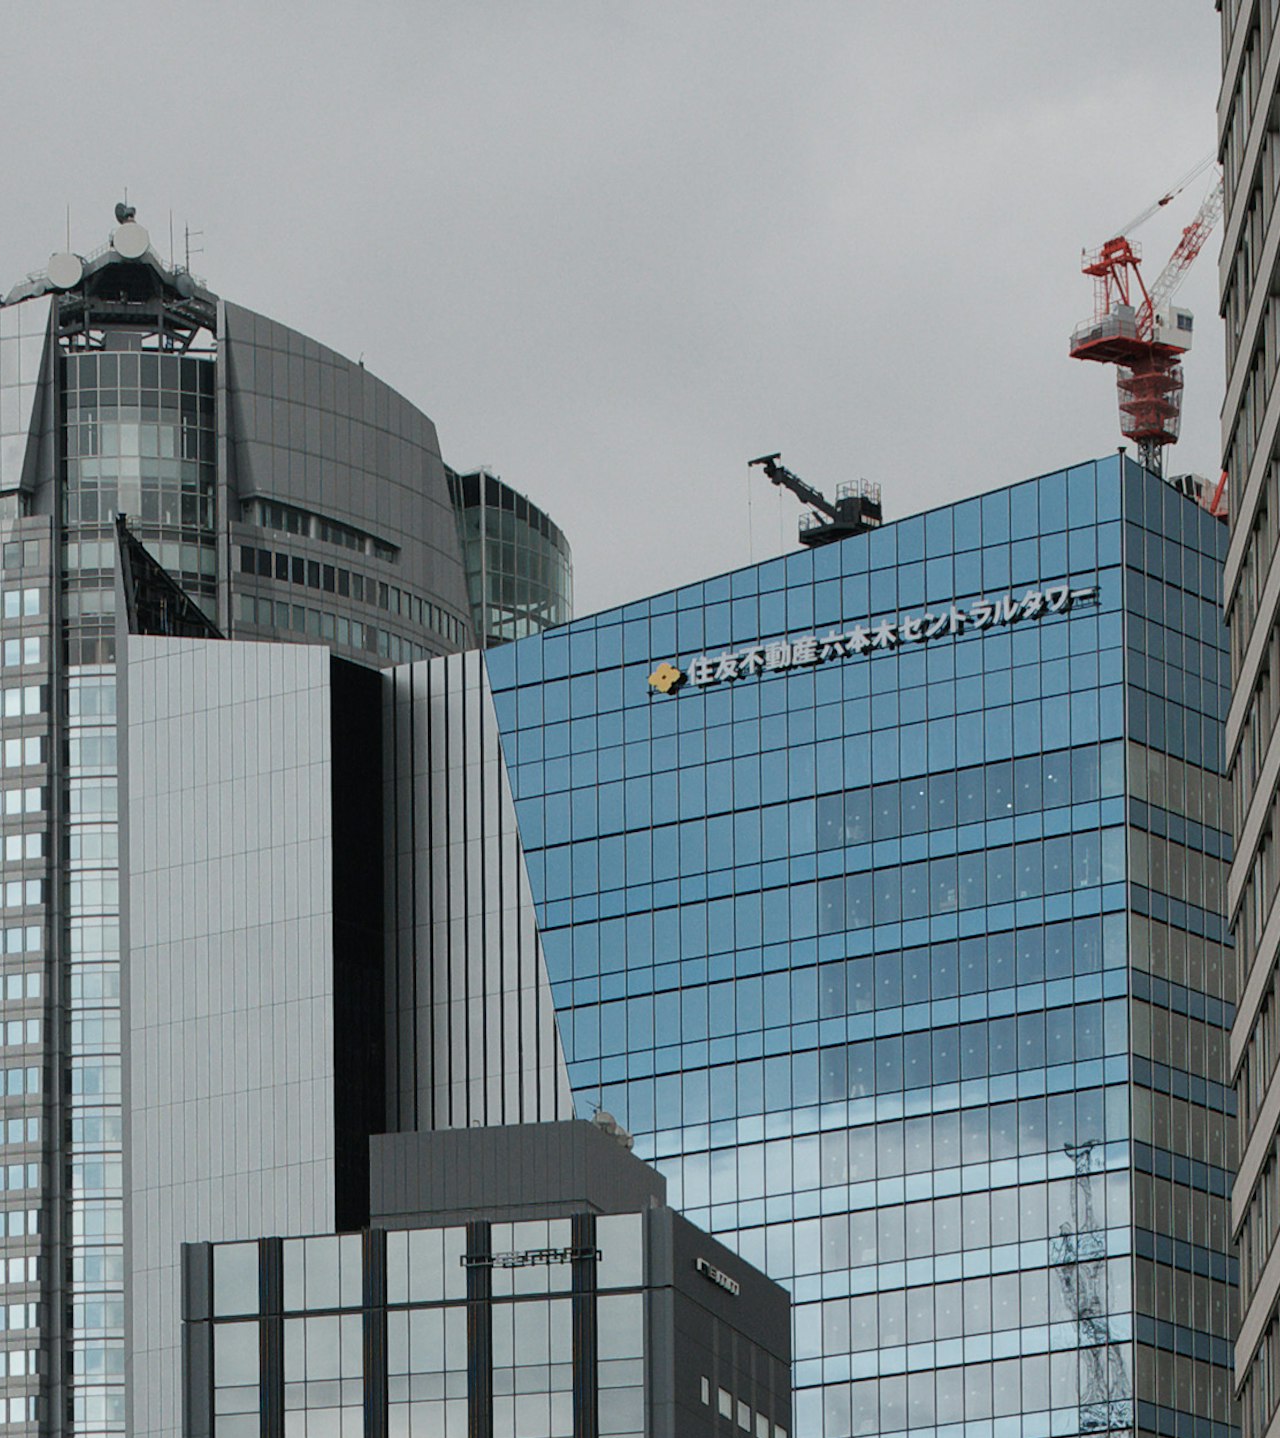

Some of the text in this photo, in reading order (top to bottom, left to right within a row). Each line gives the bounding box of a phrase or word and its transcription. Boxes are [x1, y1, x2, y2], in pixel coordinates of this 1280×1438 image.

[687, 584, 1095, 686] 住友不動産六本木セントラルタワー
